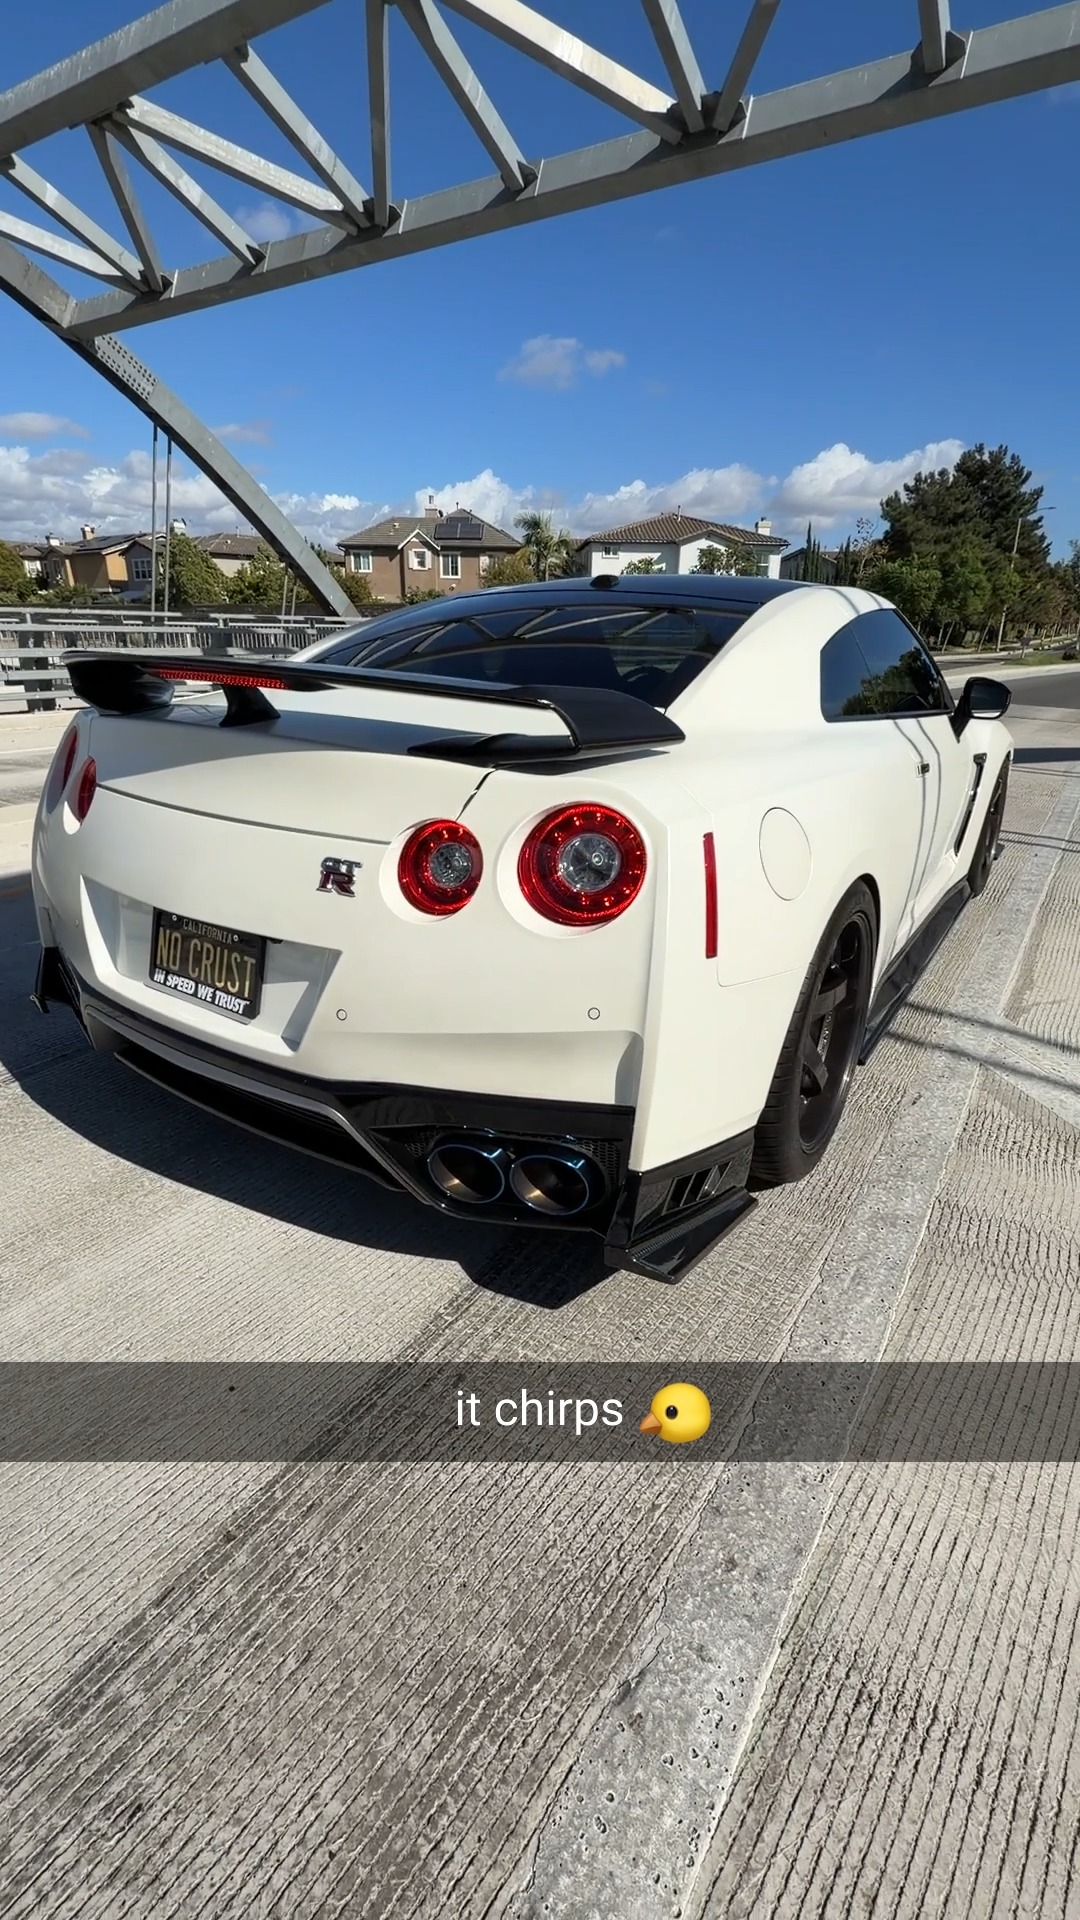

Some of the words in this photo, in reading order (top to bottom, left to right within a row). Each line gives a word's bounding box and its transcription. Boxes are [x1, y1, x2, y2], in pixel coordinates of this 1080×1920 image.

[183, 919, 232, 944] CALIFORNIA
[156, 926, 182, 971] NO
[188, 938, 256, 998] CRUST
[153, 968, 166, 984] IN
[166, 973, 196, 995] SPEED
[197, 983, 214, 1003] WE
[214, 991, 247, 1014] TRUST
